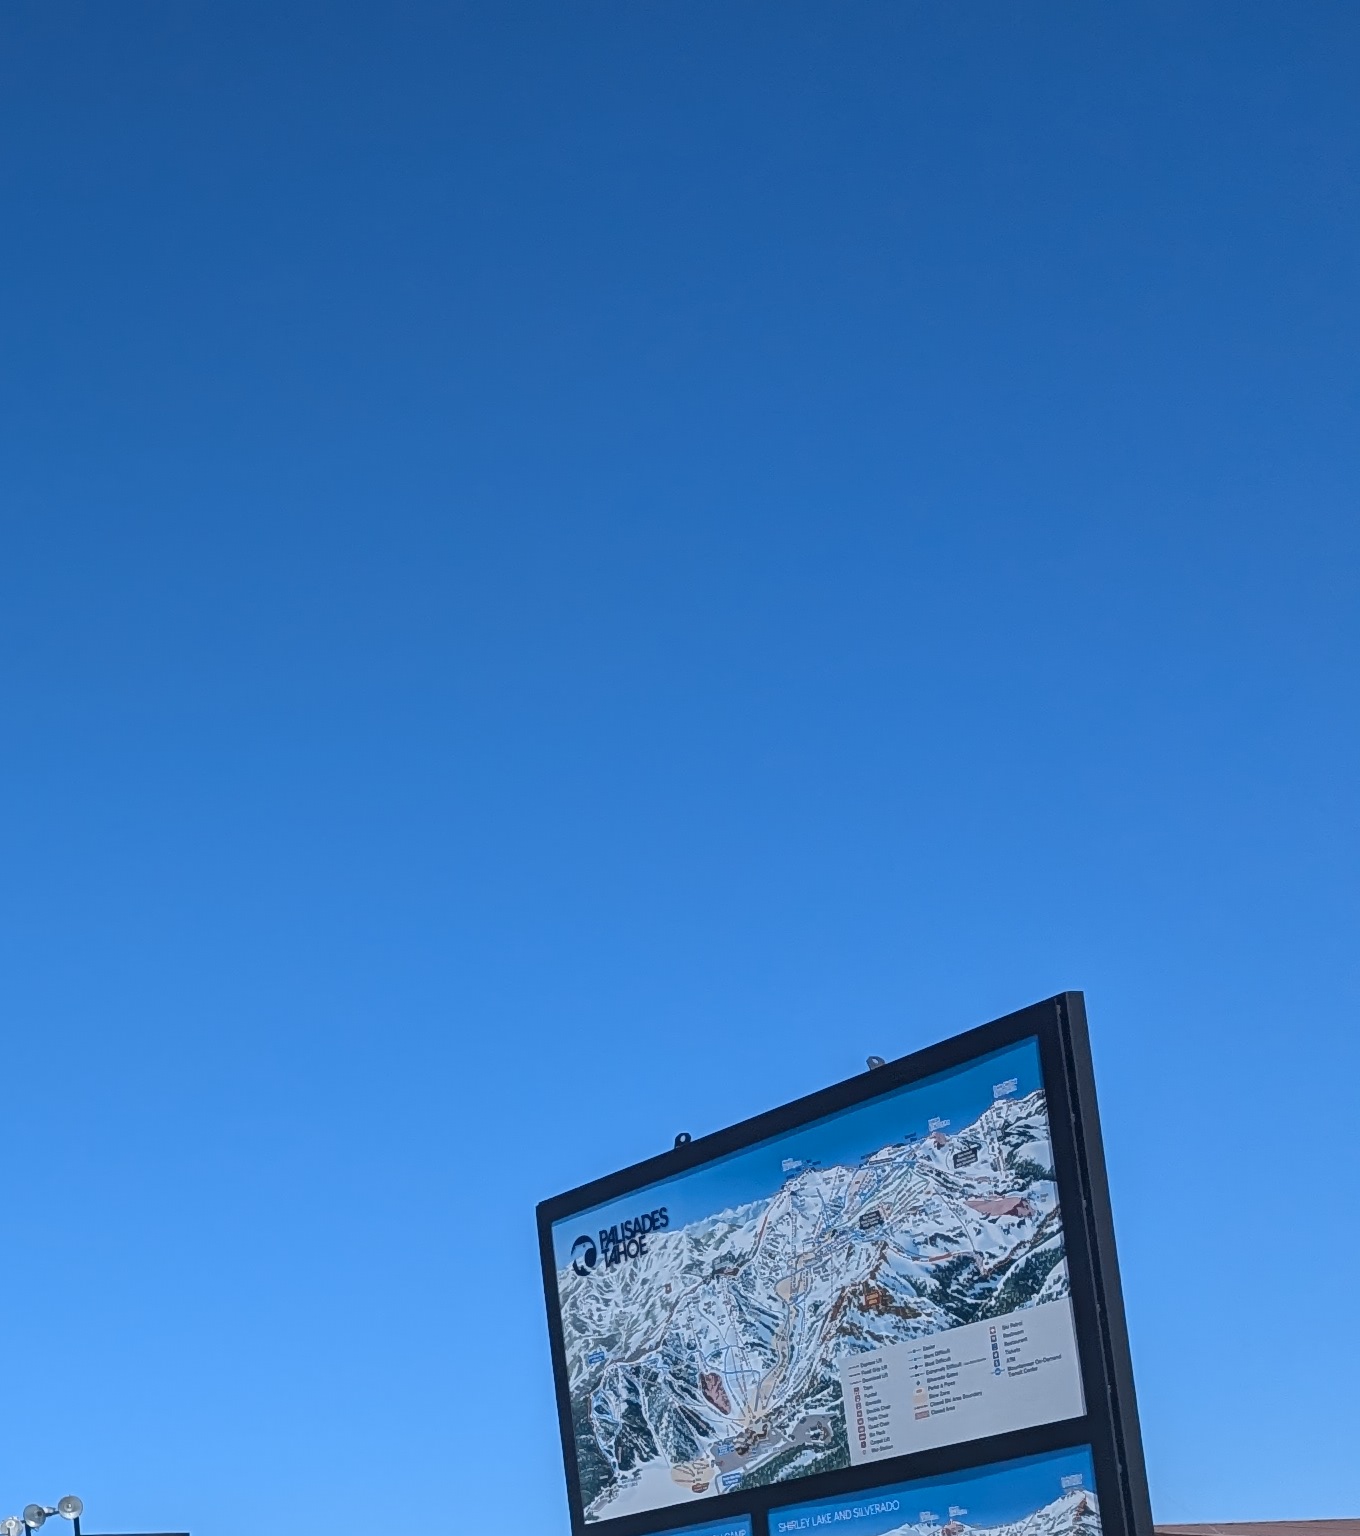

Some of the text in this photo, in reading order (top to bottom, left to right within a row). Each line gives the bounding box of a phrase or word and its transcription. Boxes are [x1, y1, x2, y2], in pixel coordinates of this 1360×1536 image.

[599, 1206, 669, 1250] PALISADES
[601, 1235, 649, 1269] TAHOE
[778, 1500, 900, 1533] SHIRLEY LAKE AND SILVERADO
